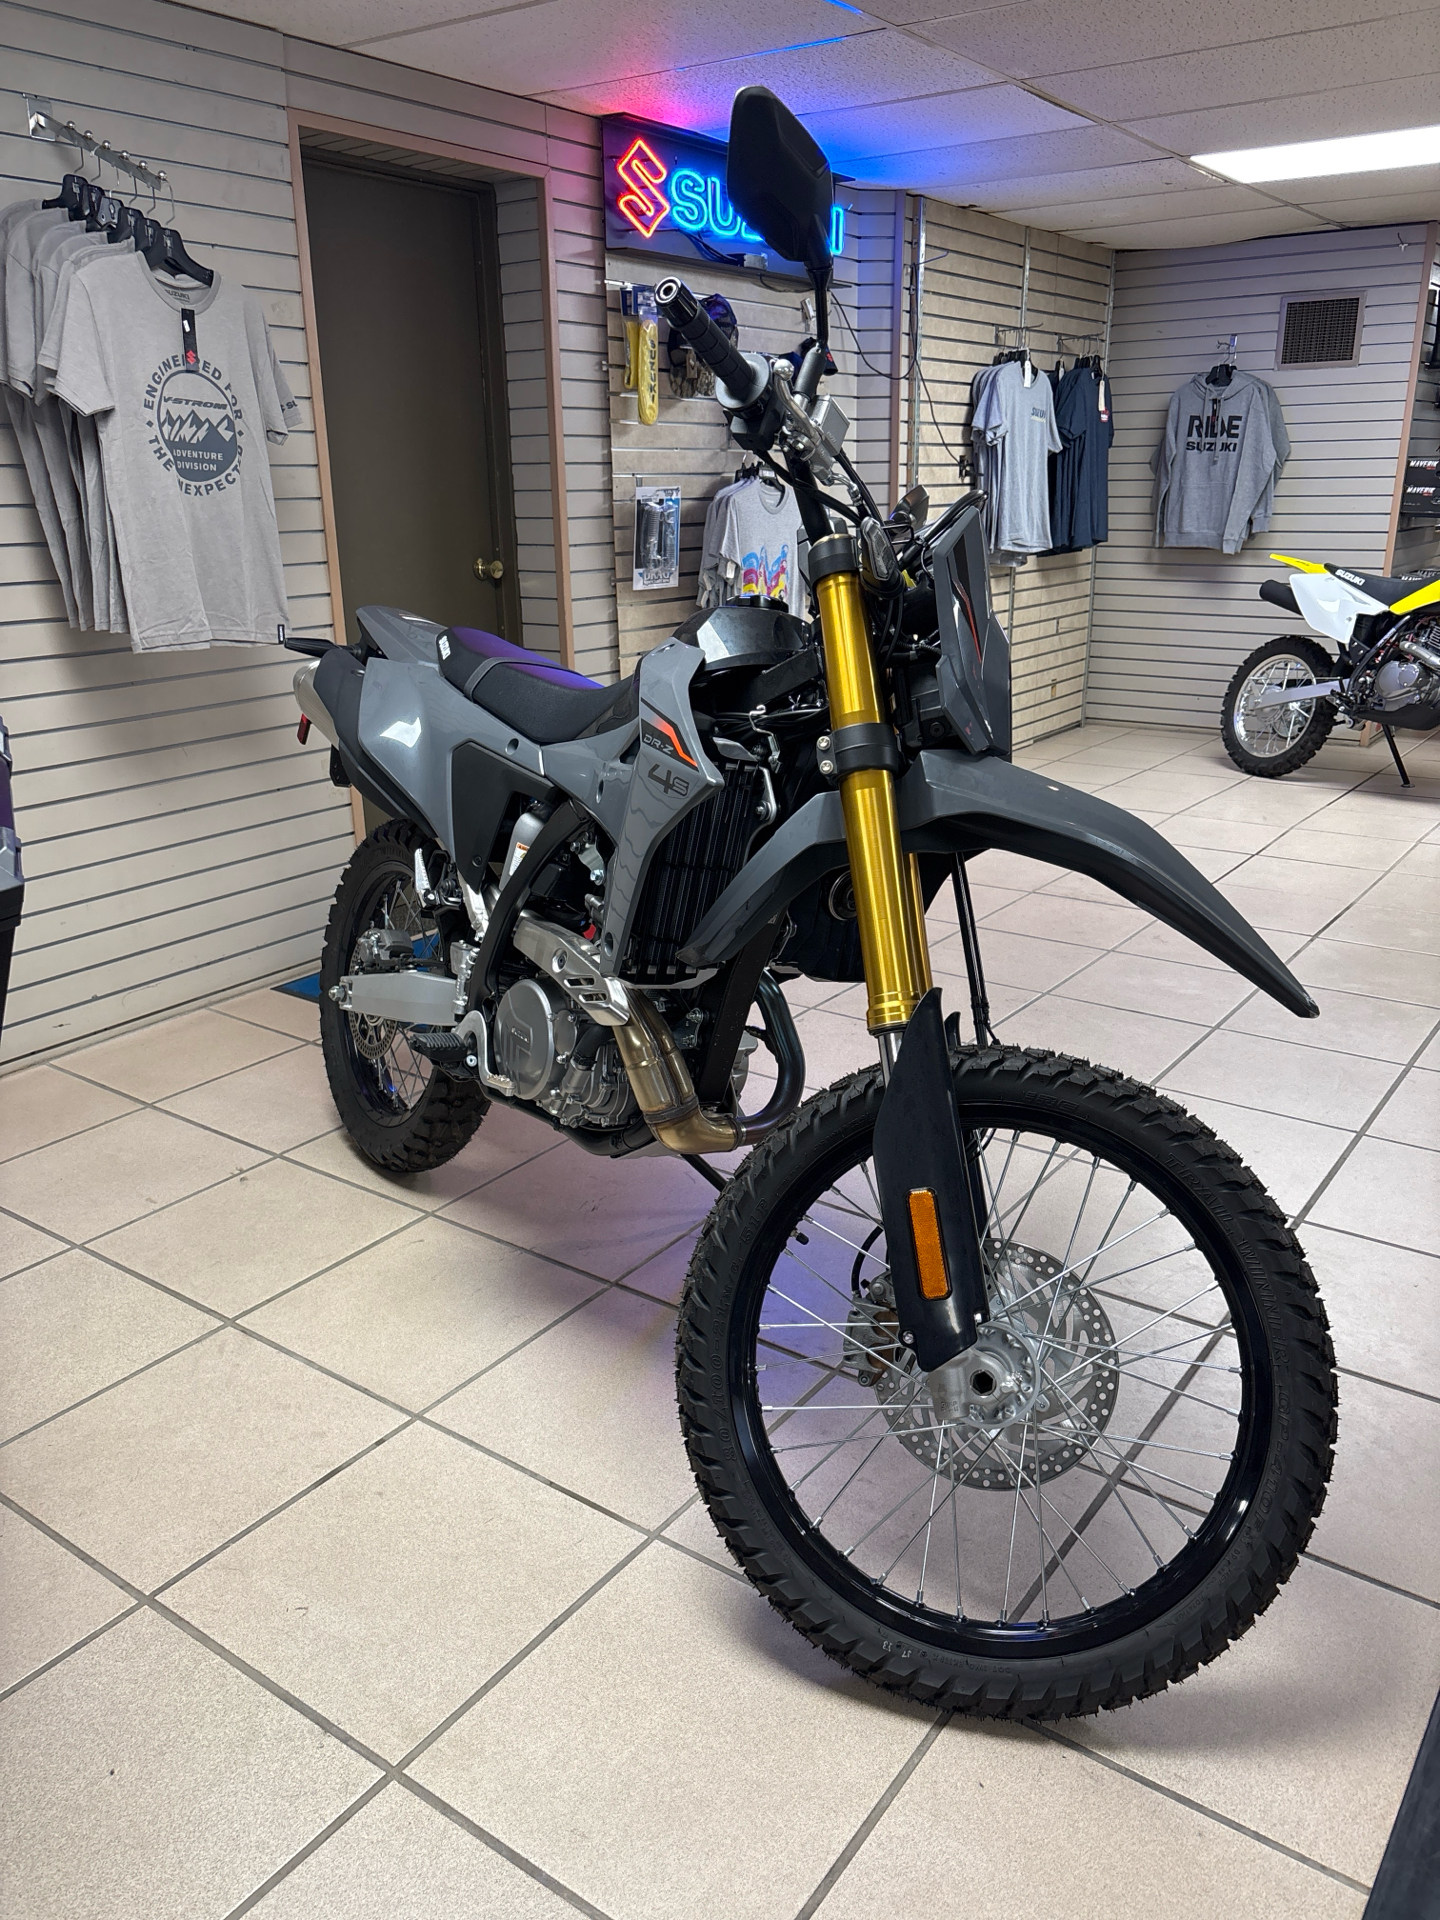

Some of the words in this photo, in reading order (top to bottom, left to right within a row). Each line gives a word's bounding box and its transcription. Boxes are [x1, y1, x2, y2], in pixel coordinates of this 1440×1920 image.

[148, 434, 176, 473] THE
[176, 460, 218, 472] DIVISION
[1334, 569, 1366, 587] SUZUKI
[1164, 1151, 1234, 1232] TRAIL
[740, 1196, 768, 1244] 51P
